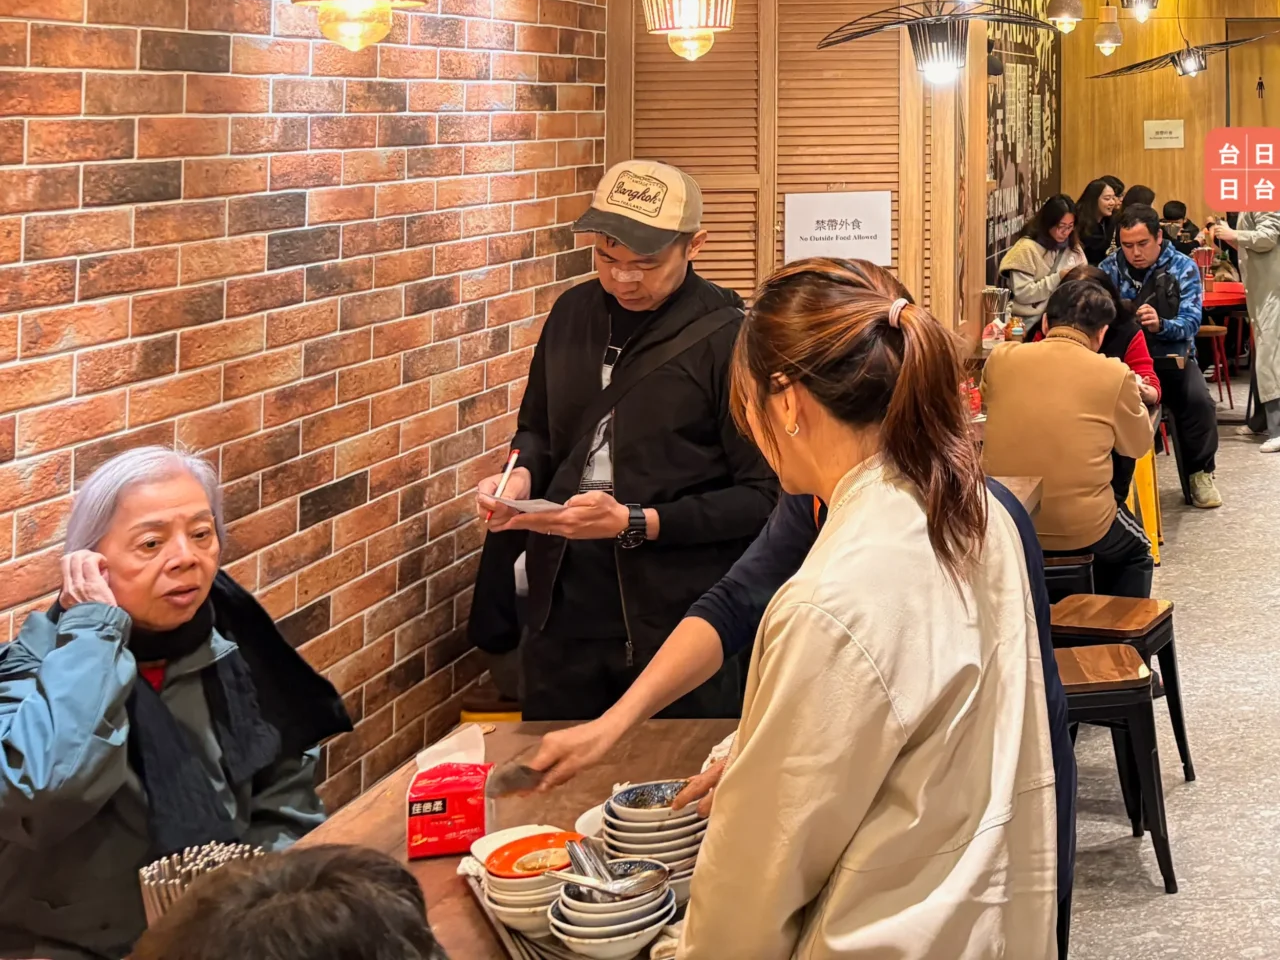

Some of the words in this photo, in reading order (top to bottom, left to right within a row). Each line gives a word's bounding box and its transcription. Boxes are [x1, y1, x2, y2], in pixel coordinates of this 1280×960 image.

[614, 181, 661, 205] Bangkok
[620, 200, 643, 211] THAILAND
[815, 218, 862, 231] 禁帶外食
[810, 234, 834, 242] Outside
